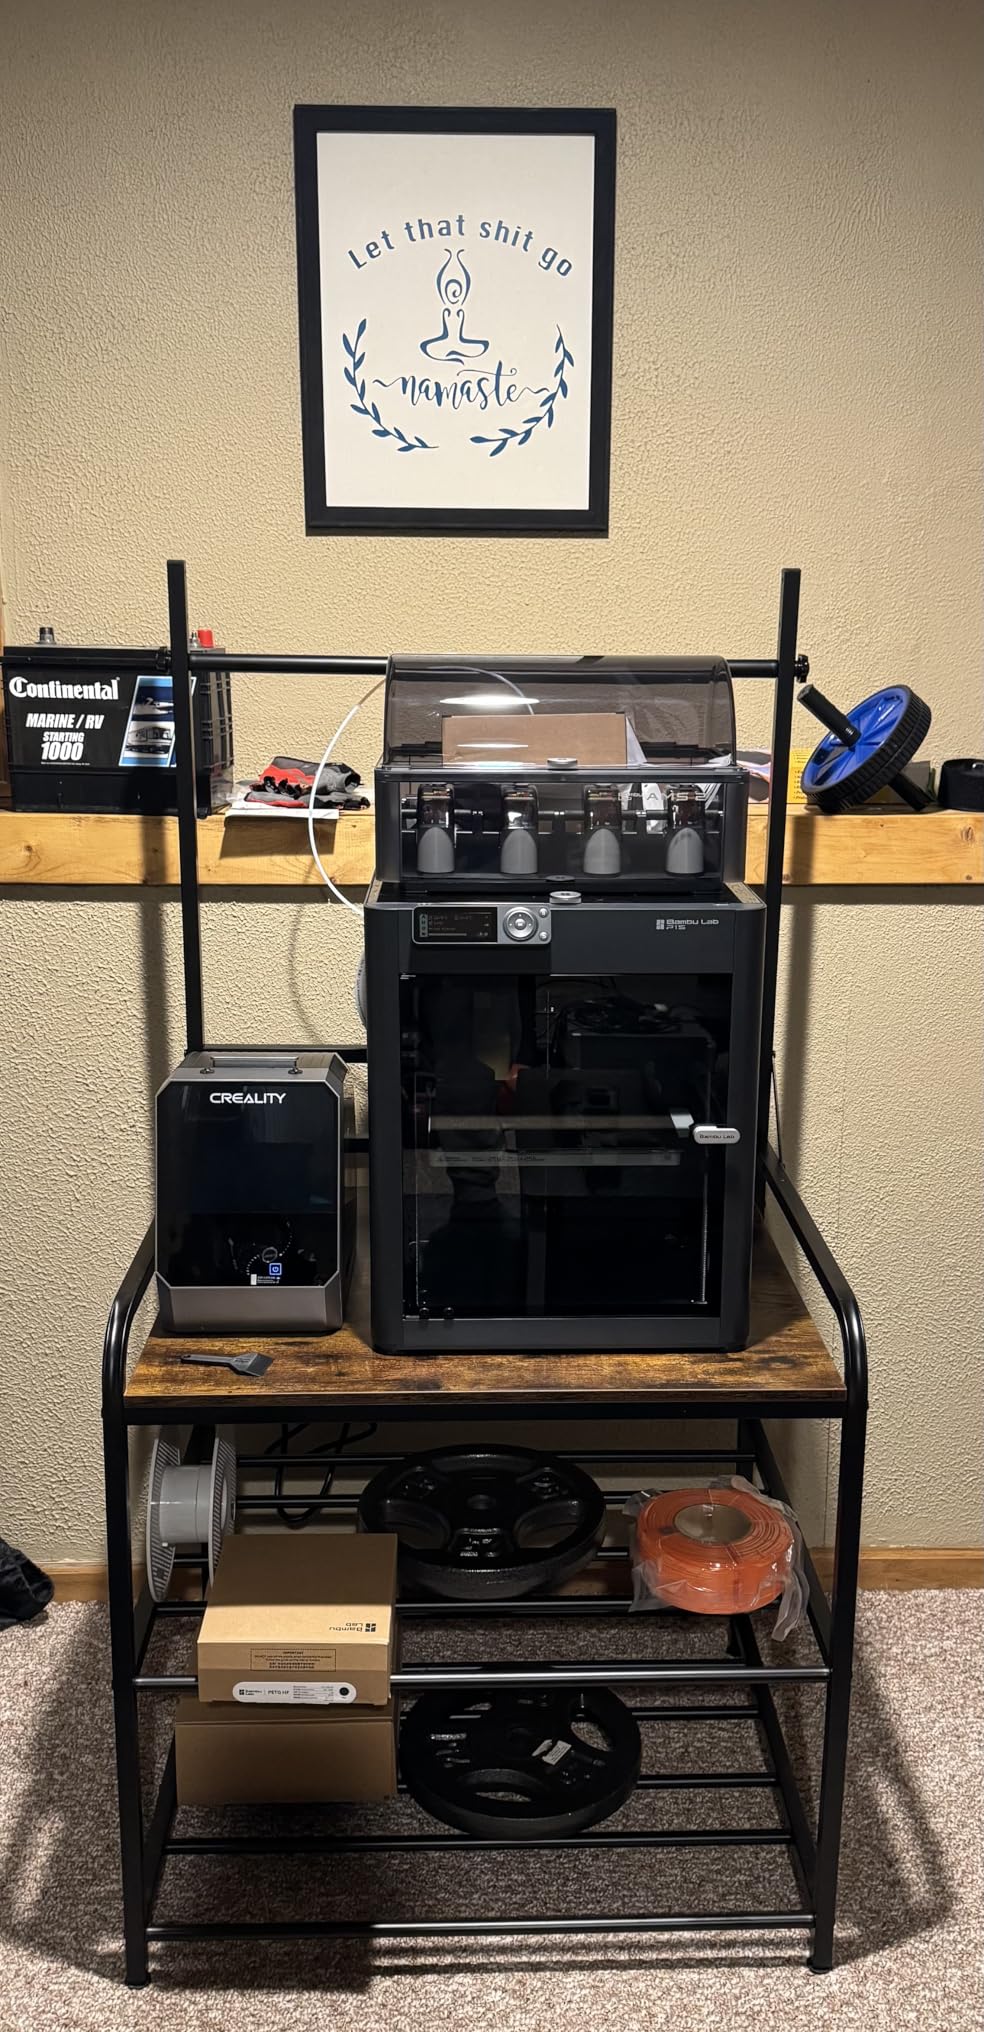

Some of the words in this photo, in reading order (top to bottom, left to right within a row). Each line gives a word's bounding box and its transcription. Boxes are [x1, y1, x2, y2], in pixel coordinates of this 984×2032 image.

[347, 229, 395, 270] Let
[404, 214, 465, 242] that
[479, 219, 534, 252] shit
[538, 247, 573, 277] go
[373, 360, 549, 410] namaste
[9, 676, 119, 700] Continental
[25, 713, 76, 728] MARINE
[85, 714, 105, 729] RV
[42, 731, 85, 742] STARTING
[41, 741, 84, 761] 1000
[646, 792, 689, 801] AMS
[209, 1092, 287, 1104] CREALITY
